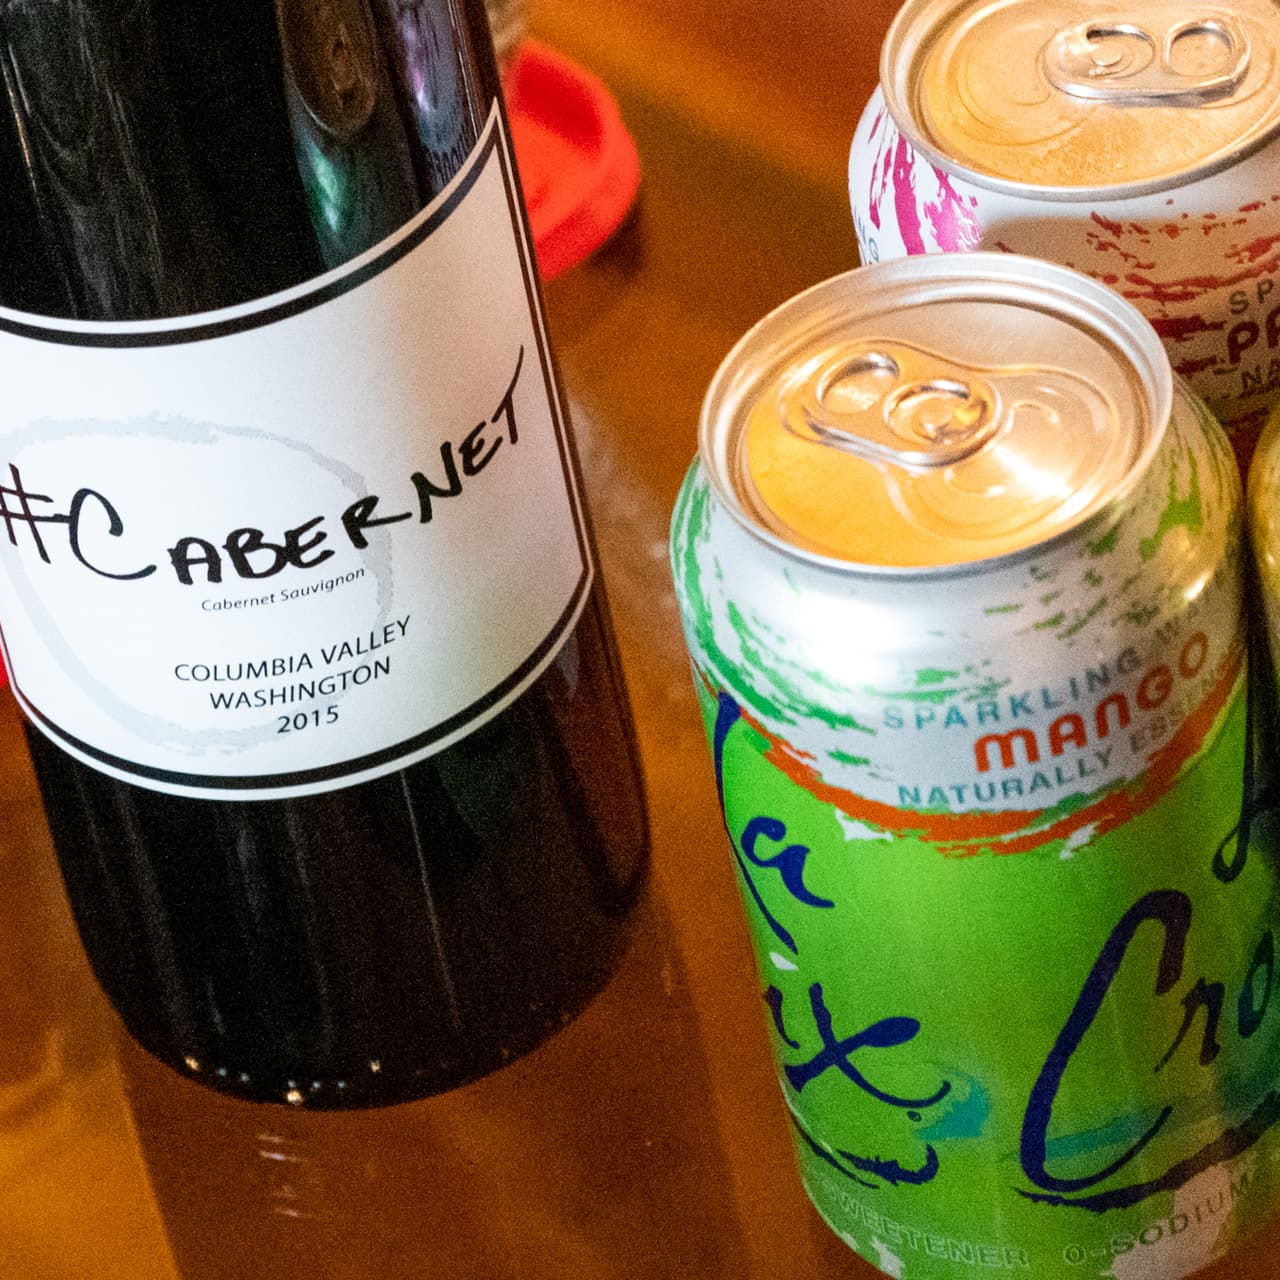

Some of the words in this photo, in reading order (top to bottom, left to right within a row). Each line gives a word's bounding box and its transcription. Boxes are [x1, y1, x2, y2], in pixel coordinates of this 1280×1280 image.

[200, 590, 275, 612] Cabernet
[279, 567, 365, 604] Sauvignon
[174, 652, 313, 682] COLUMBIA
[321, 615, 412, 665] VALLEY
[209, 657, 392, 710] WASHINGTON
[882, 648, 1143, 730] SPARKLING
[973, 631, 1210, 774] MANGO
[276, 705, 340, 734] 2015
[897, 747, 1114, 806] NATURALLY
